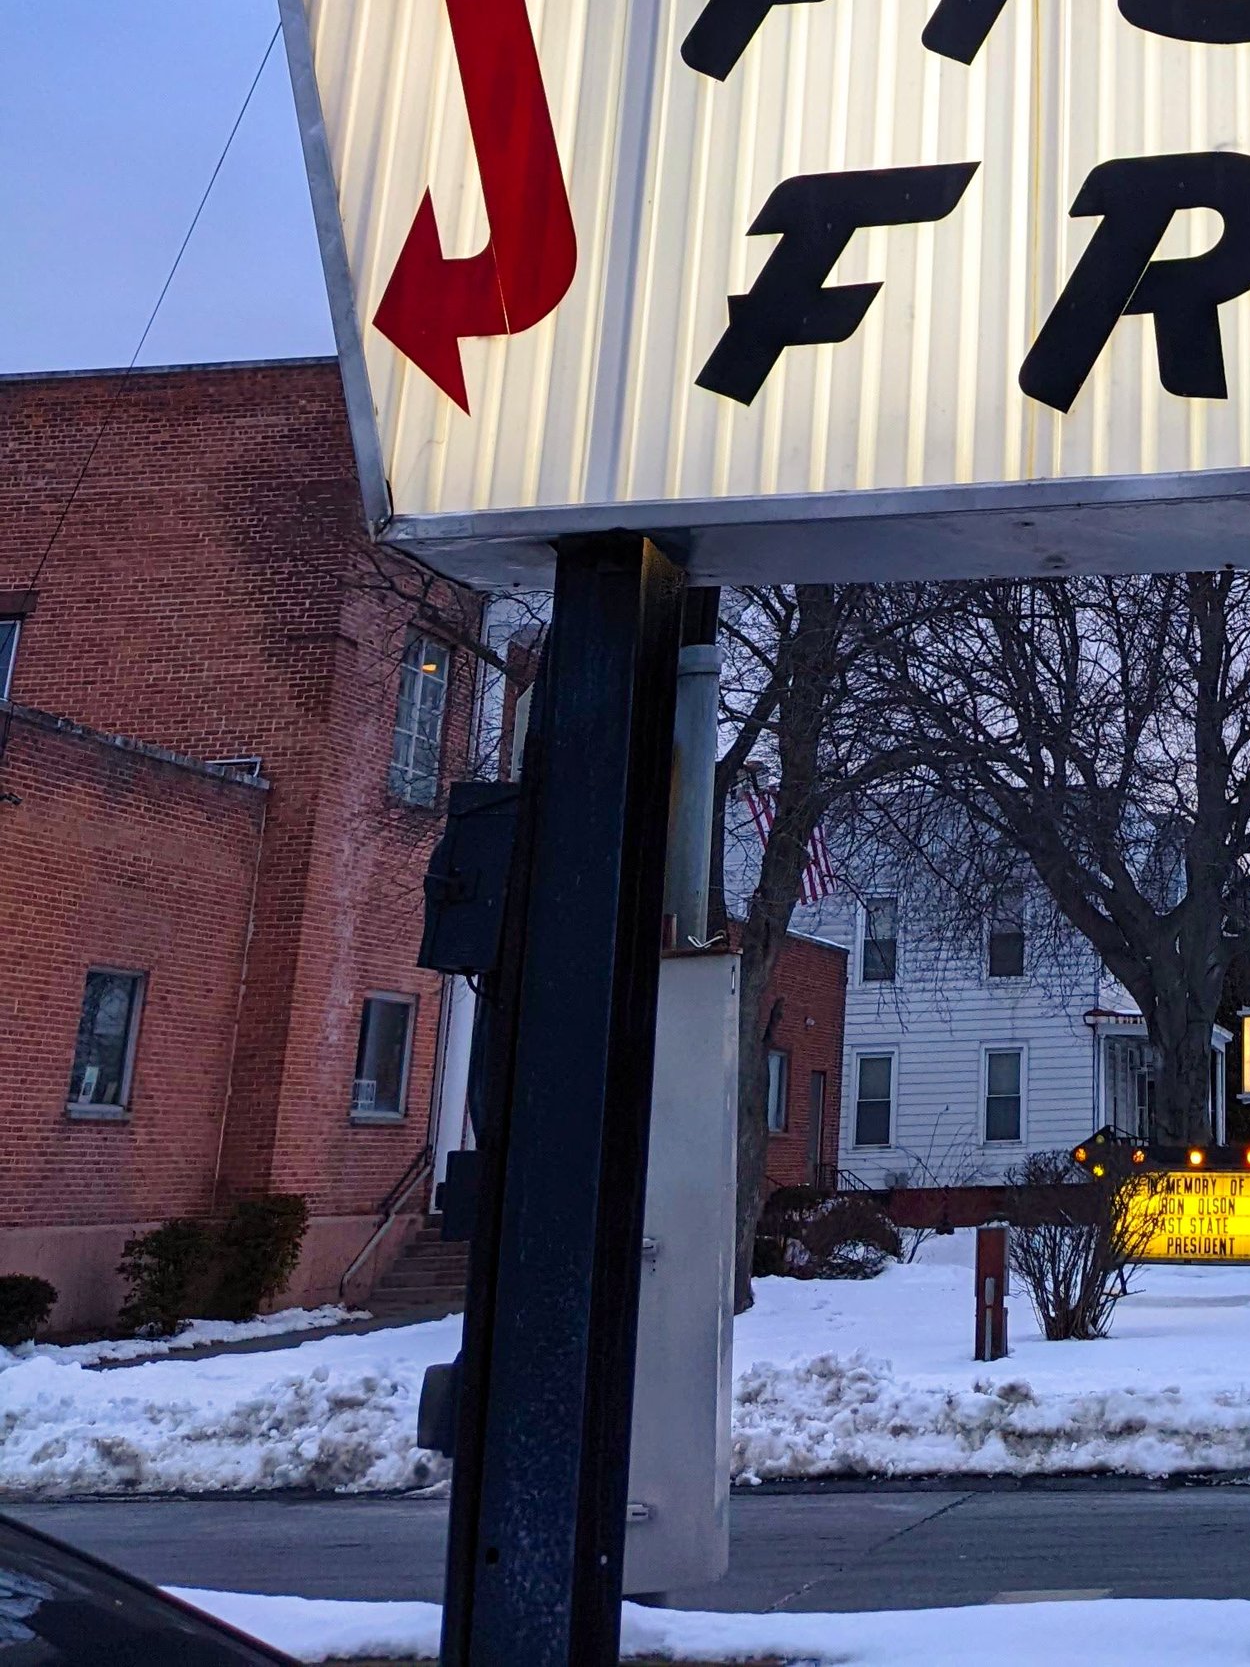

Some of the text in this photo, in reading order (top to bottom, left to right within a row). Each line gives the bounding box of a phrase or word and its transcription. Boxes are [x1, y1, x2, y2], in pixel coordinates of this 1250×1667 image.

[1166, 1177, 1217, 1195] MEMORY
[1230, 1178, 1245, 1196] OF
[1161, 1197, 1236, 1215] RON OLSON
[1190, 1217, 1229, 1234] STATE
[1167, 1237, 1235, 1255] PRESIDENT
